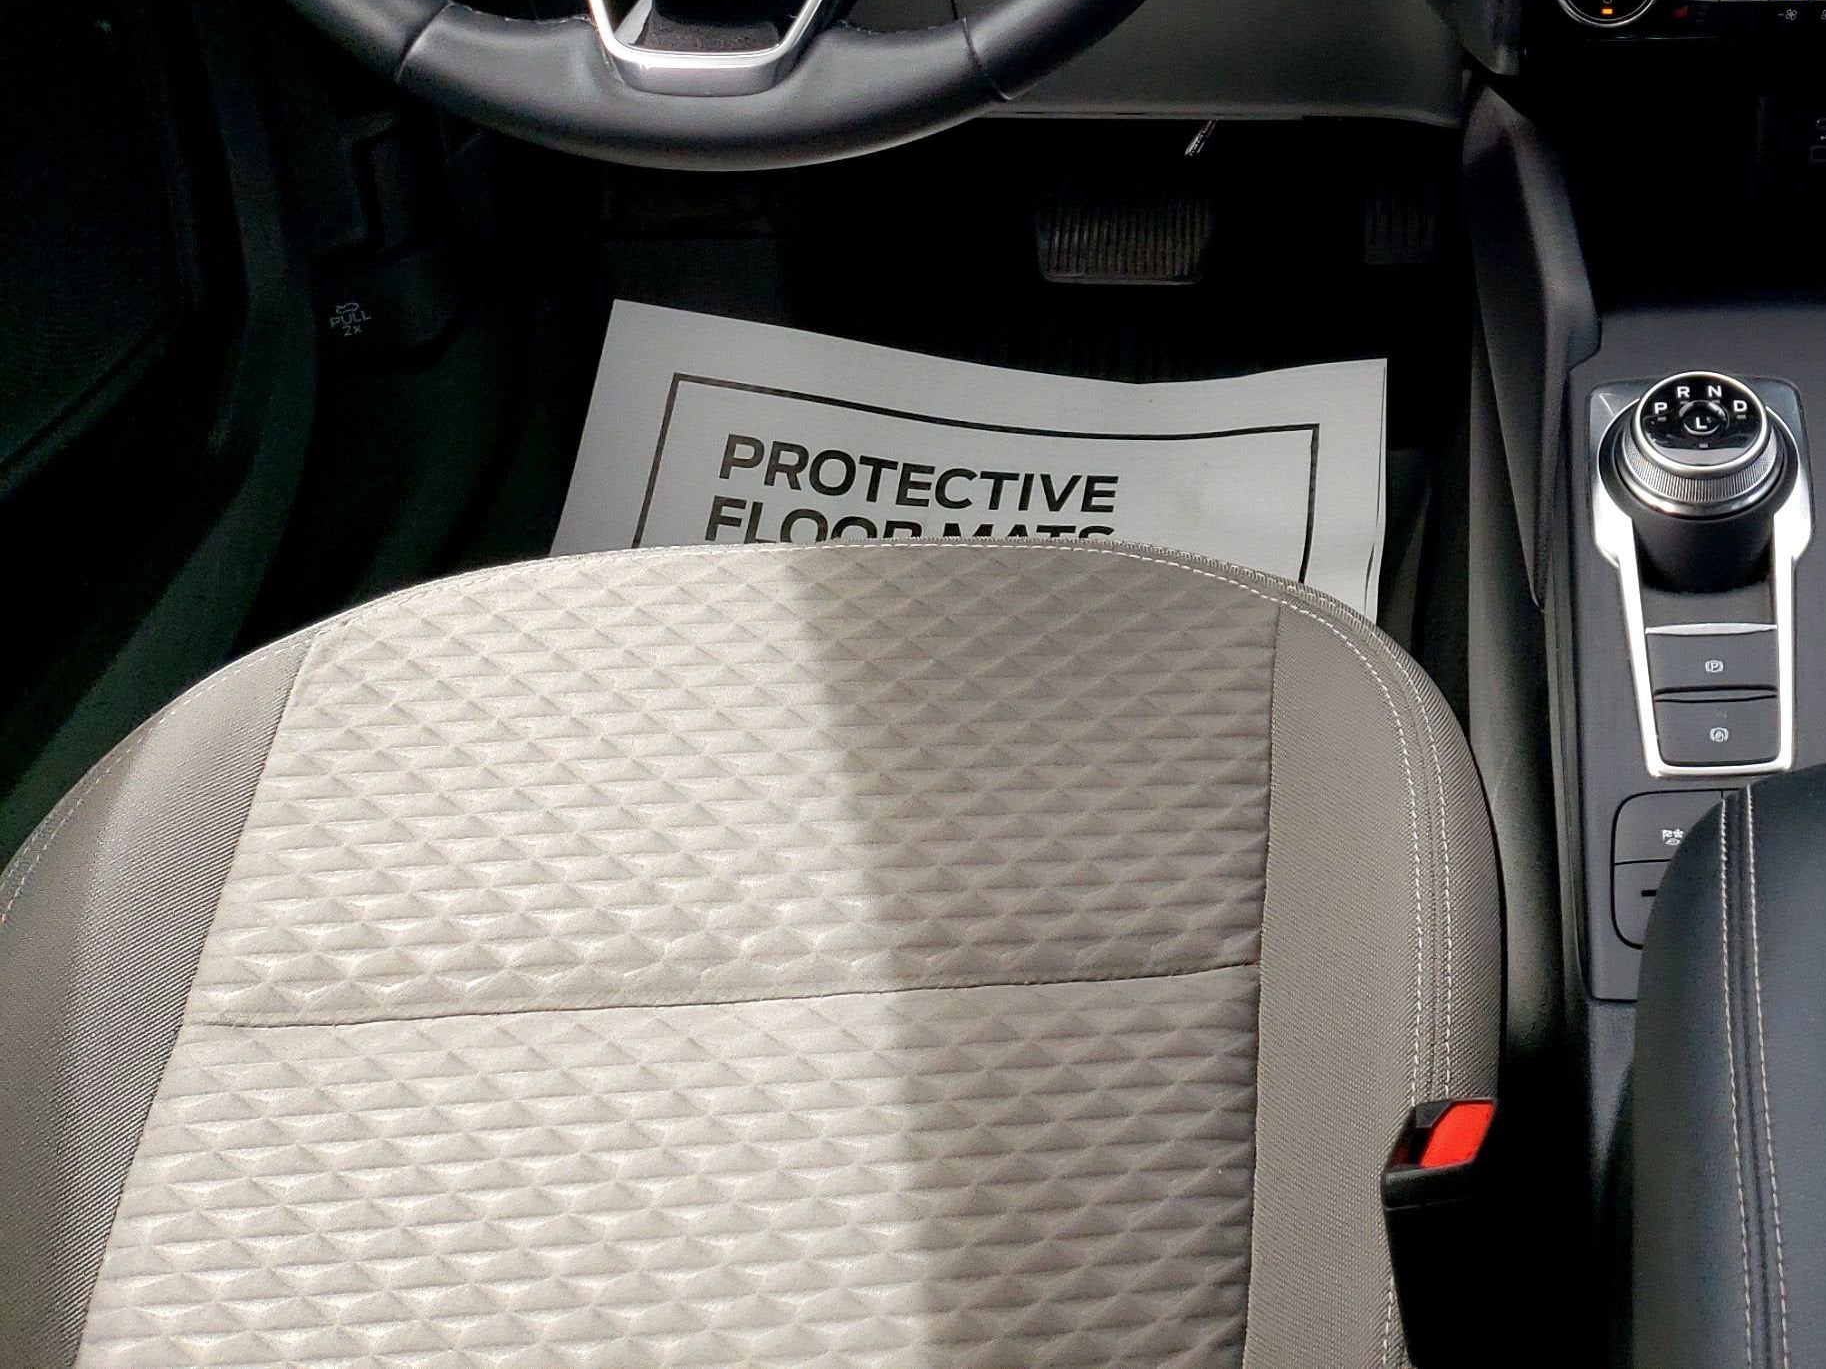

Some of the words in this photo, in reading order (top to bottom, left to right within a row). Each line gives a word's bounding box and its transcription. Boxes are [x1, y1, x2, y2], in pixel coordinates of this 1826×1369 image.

[1677, 386, 1690, 398] R
[1708, 385, 1722, 398] N
[1654, 402, 1668, 414] P
[1733, 400, 1747, 412] D
[1695, 417, 1708, 429] L
[718, 432, 1119, 513] PROTECTIVE
